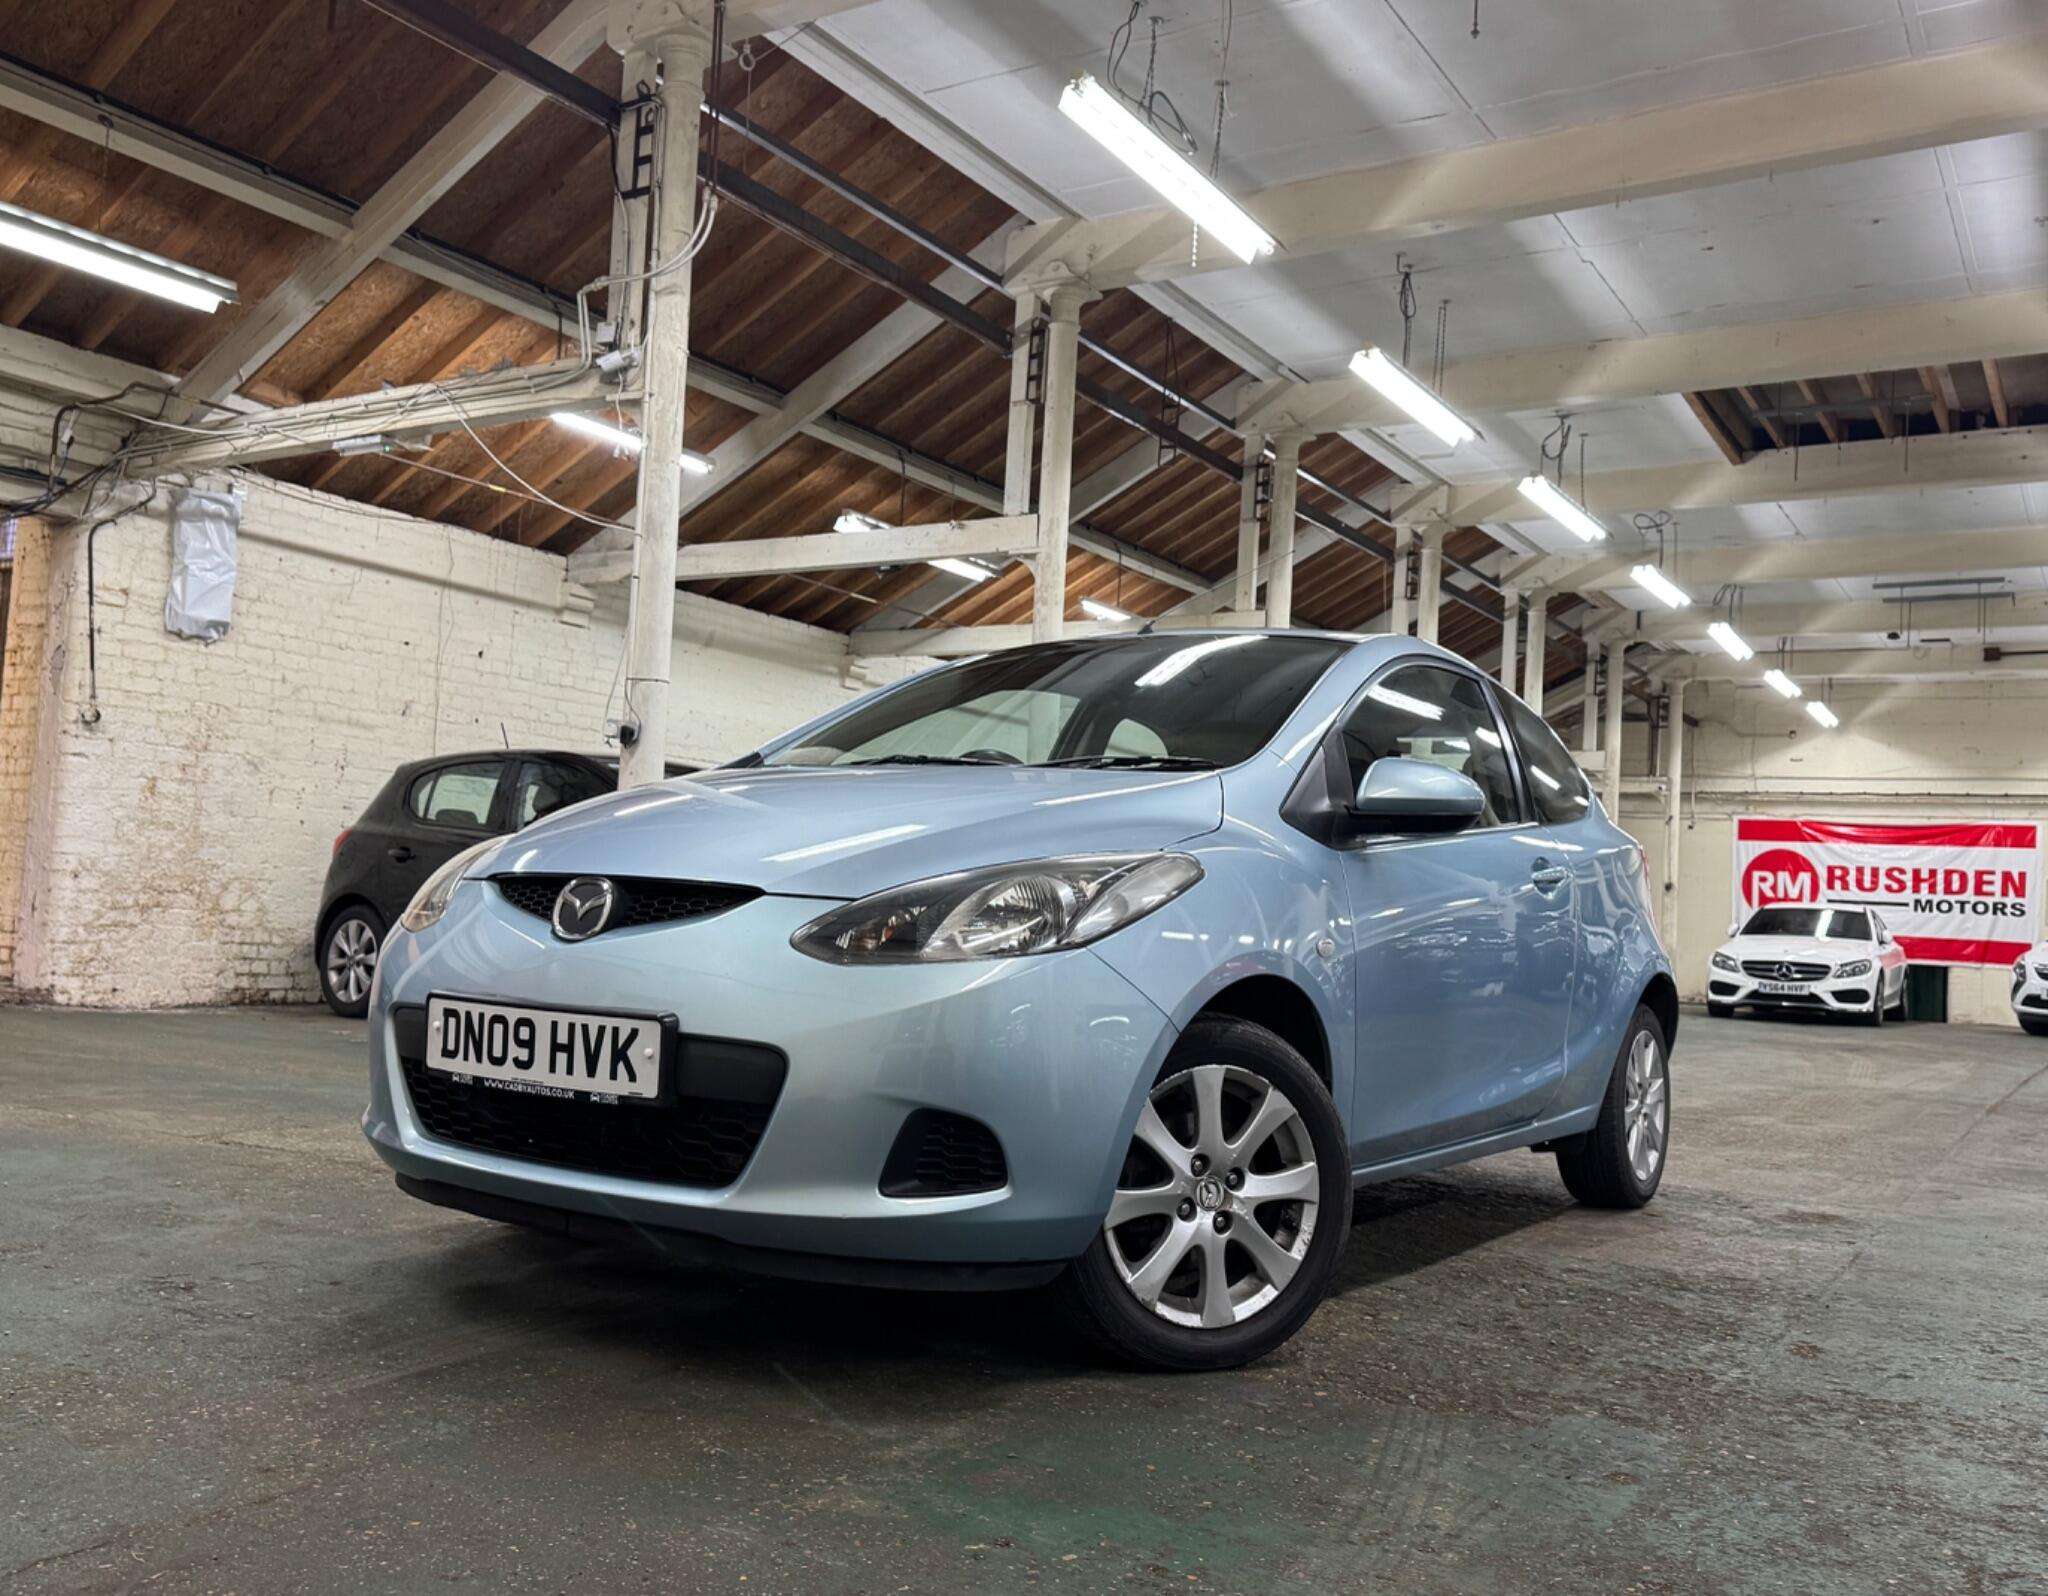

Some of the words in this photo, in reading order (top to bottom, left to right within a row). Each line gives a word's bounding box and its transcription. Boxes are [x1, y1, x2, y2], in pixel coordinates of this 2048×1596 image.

[1752, 870, 1812, 908] RM
[1827, 865, 2026, 898] RUSHDEN
[1914, 899, 2026, 917] MOTORS
[441, 1008, 536, 1070] DN09
[549, 1021, 640, 1083] HVK
